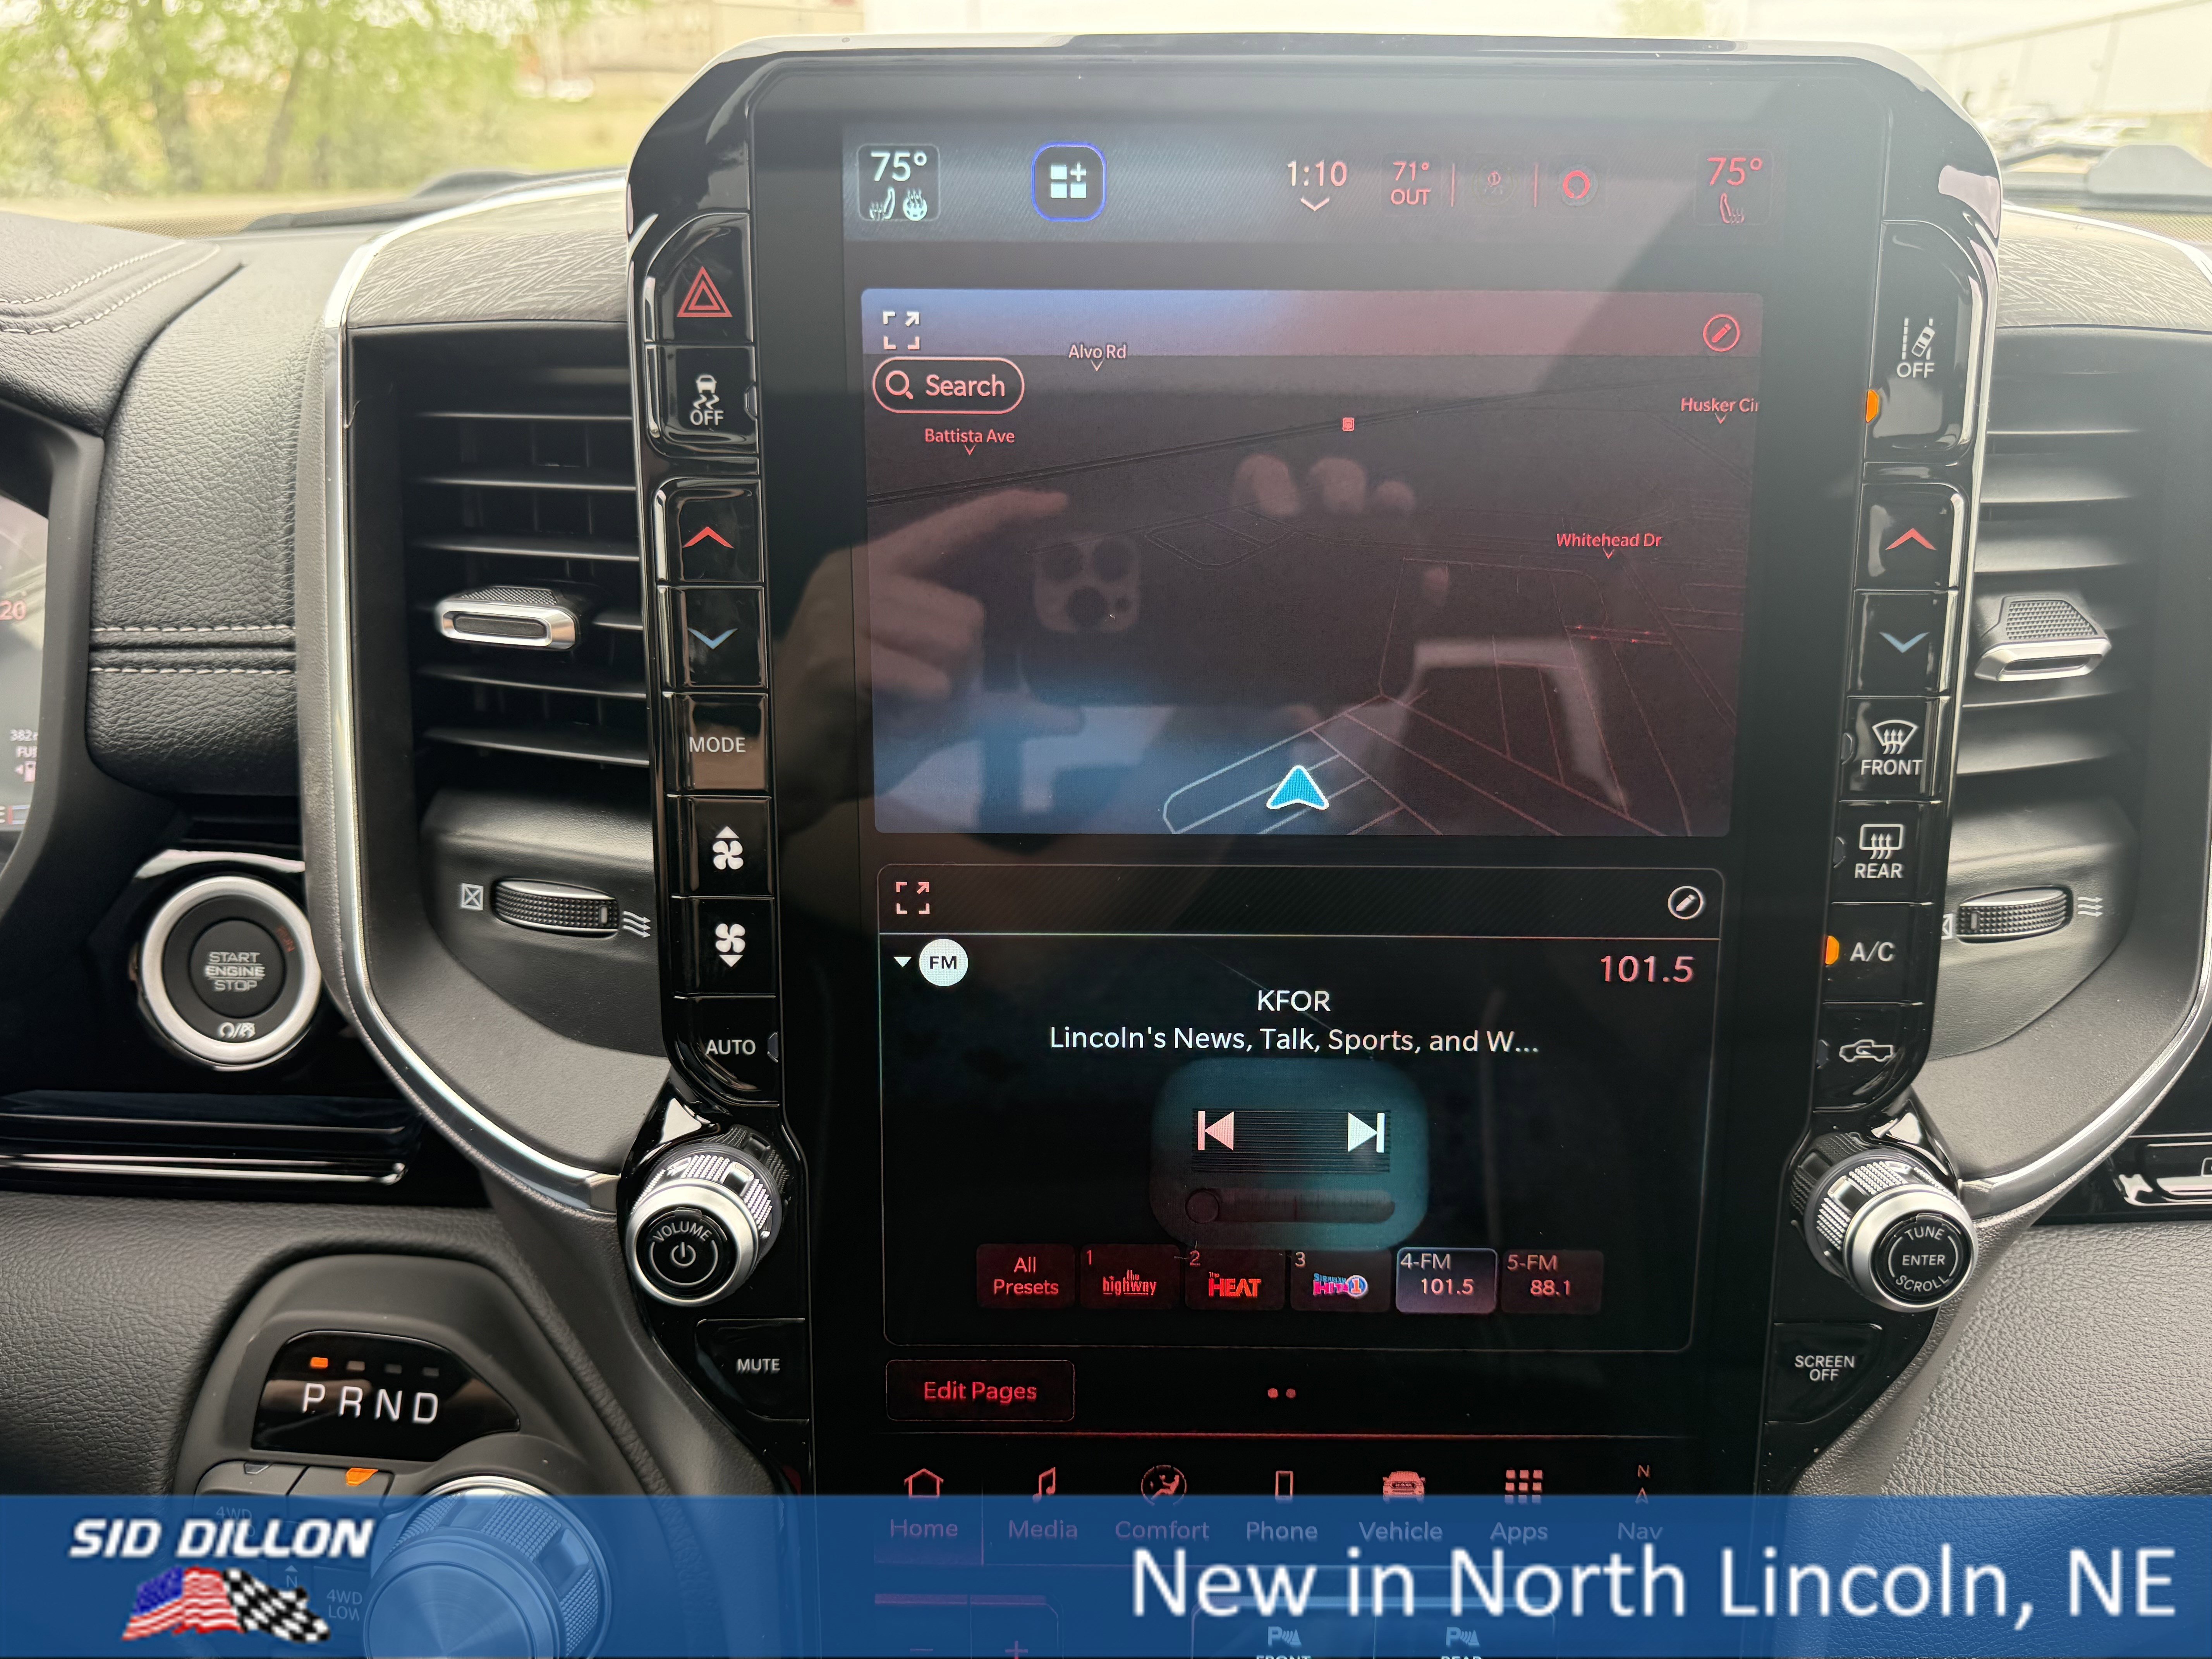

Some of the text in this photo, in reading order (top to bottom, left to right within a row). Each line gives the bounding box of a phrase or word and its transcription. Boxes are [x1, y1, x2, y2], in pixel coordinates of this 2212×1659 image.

[871, 151, 927, 182] 75°
[1287, 161, 1347, 186] 1:10
[1707, 157, 1762, 186] 75°
[1391, 189, 1431, 205] OUT
[1069, 344, 1126, 359] Alvo Rd
[1897, 362, 1935, 378] OFF
[926, 374, 1005, 397] Search
[1681, 397, 1736, 412] Husker
[690, 410, 724, 426] OFF
[925, 428, 1015, 443] Battista Ave
[1556, 533, 1662, 547] Whitehead Dr
[689, 737, 746, 753] MODE
[1861, 759, 1924, 775] FRONT
[1855, 863, 1903, 879] REAR
[209, 951, 261, 963] START
[1850, 941, 1896, 962] A/C
[930, 956, 957, 969] FM
[1600, 956, 1695, 982] 101.5
[205, 965, 266, 977] ENGINE
[214, 979, 258, 992] STOP
[1257, 990, 1331, 1012] KFOR
[705, 1039, 756, 1056] AUTO
[1051, 1026, 1166, 1048] Lincoln's
[1174, 1028, 1252, 1052] News,
[1259, 1028, 1320, 1053] Talk,
[1328, 1029, 1421, 1055] Sports,
[1429, 1030, 1477, 1052] and
[652, 1221, 713, 1244] VOLUME
[1905, 1226, 1945, 1240] TUNE
[1014, 1256, 1036, 1273] All
[1087, 1250, 1092, 1265] 1
[1190, 1250, 1200, 1266] 2
[1295, 1252, 1306, 1267] 3
[1400, 1253, 1451, 1271] 4-FM
[1507, 1254, 1559, 1271] 5-FM
[1902, 1255, 1945, 1266] ENTER
[994, 1279, 1059, 1295] Presets
[1208, 1278, 1261, 1297] HEAT
[1421, 1278, 1474, 1295] 101.5
[1530, 1279, 1571, 1296] 88.1
[1896, 1275, 1949, 1292] SCROLL
[737, 1358, 780, 1373] MUTE
[1794, 1355, 1855, 1368] SCREEN
[1809, 1369, 1839, 1382] OFF
[924, 1381, 1037, 1404] Edit Pages
[1637, 1465, 1650, 1479] N
[891, 1518, 958, 1538] Home
[1009, 1520, 1078, 1540] Media
[1115, 1520, 1210, 1541] Comfort
[1247, 1521, 1318, 1541] Phone
[1359, 1522, 1443, 1542] Vehicle
[1490, 1522, 1548, 1544] Apps
[1618, 1523, 1663, 1540] Nav
[326, 1589, 362, 1605] 4WD
